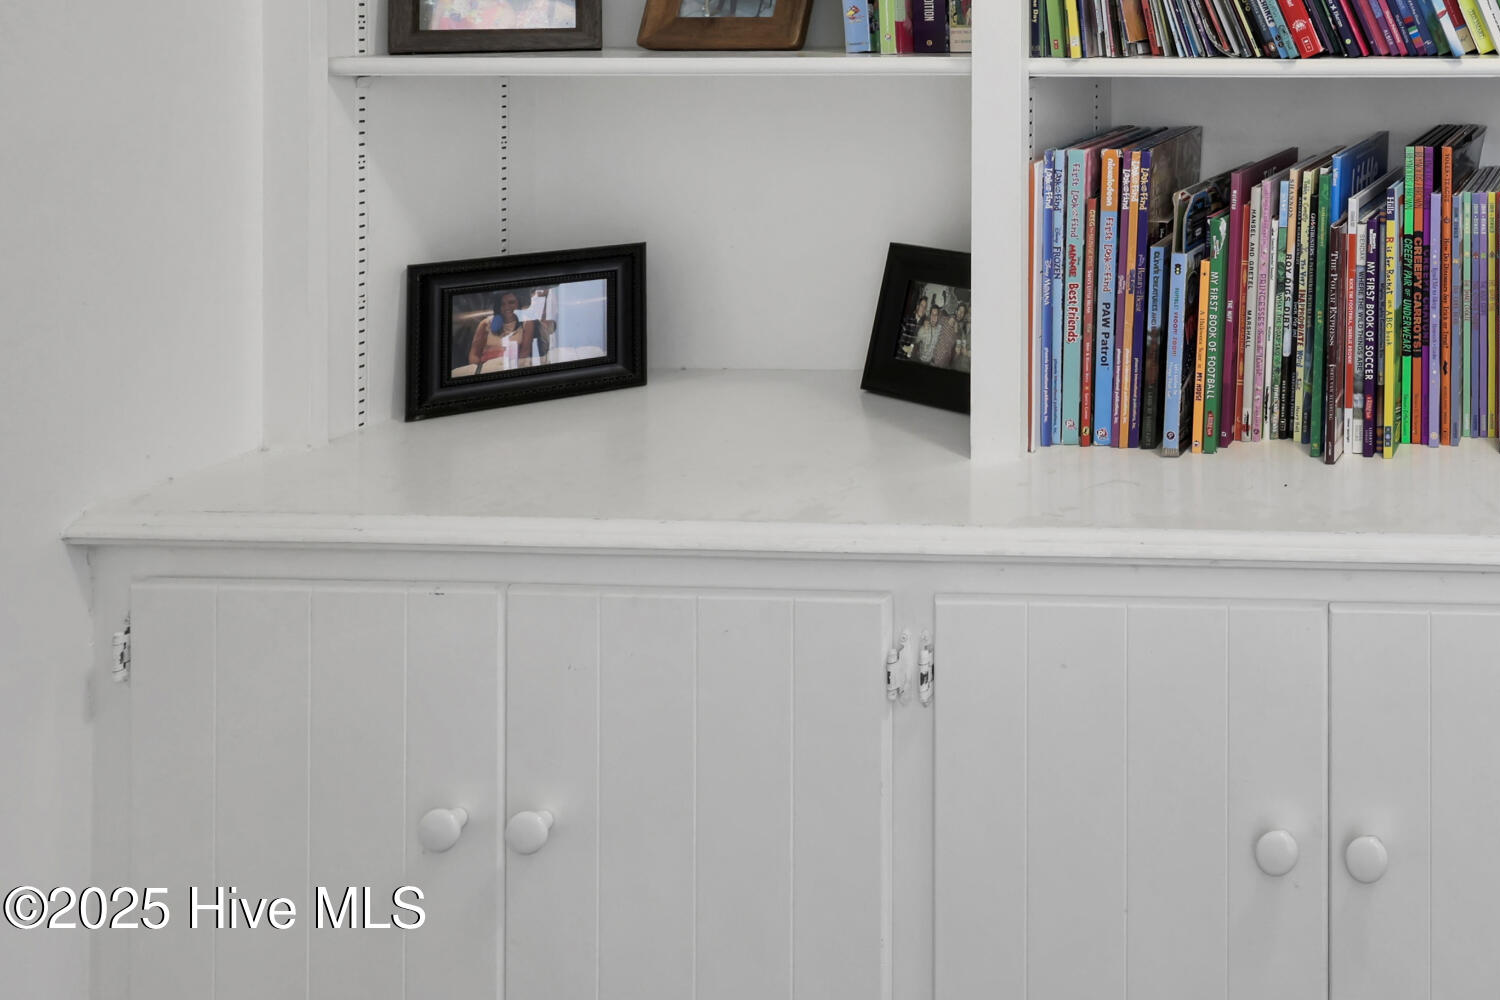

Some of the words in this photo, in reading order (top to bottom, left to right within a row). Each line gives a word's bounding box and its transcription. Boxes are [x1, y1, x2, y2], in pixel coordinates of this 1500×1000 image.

[1105, 158, 1114, 206] nickelodeon
[1330, 251, 1339, 270] THE
[1366, 261, 1375, 274] MY
[1413, 237, 1423, 289] CREEPY
[1211, 271, 1220, 284] MY
[1329, 273, 1339, 303] POLAR
[1366, 278, 1375, 301] FIRST
[1068, 282, 1080, 304] Best
[1209, 287, 1219, 311] FIRST
[1067, 306, 1079, 343] Friends
[1101, 302, 1111, 327] PAW
[1208, 314, 1218, 338] BOOK
[1328, 306, 1338, 346] EXPRESS
[1365, 304, 1374, 328] BOOK
[1412, 292, 1422, 352] CARROTS!
[1208, 341, 1217, 352] OF
[1365, 331, 1374, 342] OF
[1100, 332, 1110, 366] Patrol
[1364, 345, 1373, 380] SOCCER
[1206, 356, 1217, 400] FOOTBALL
